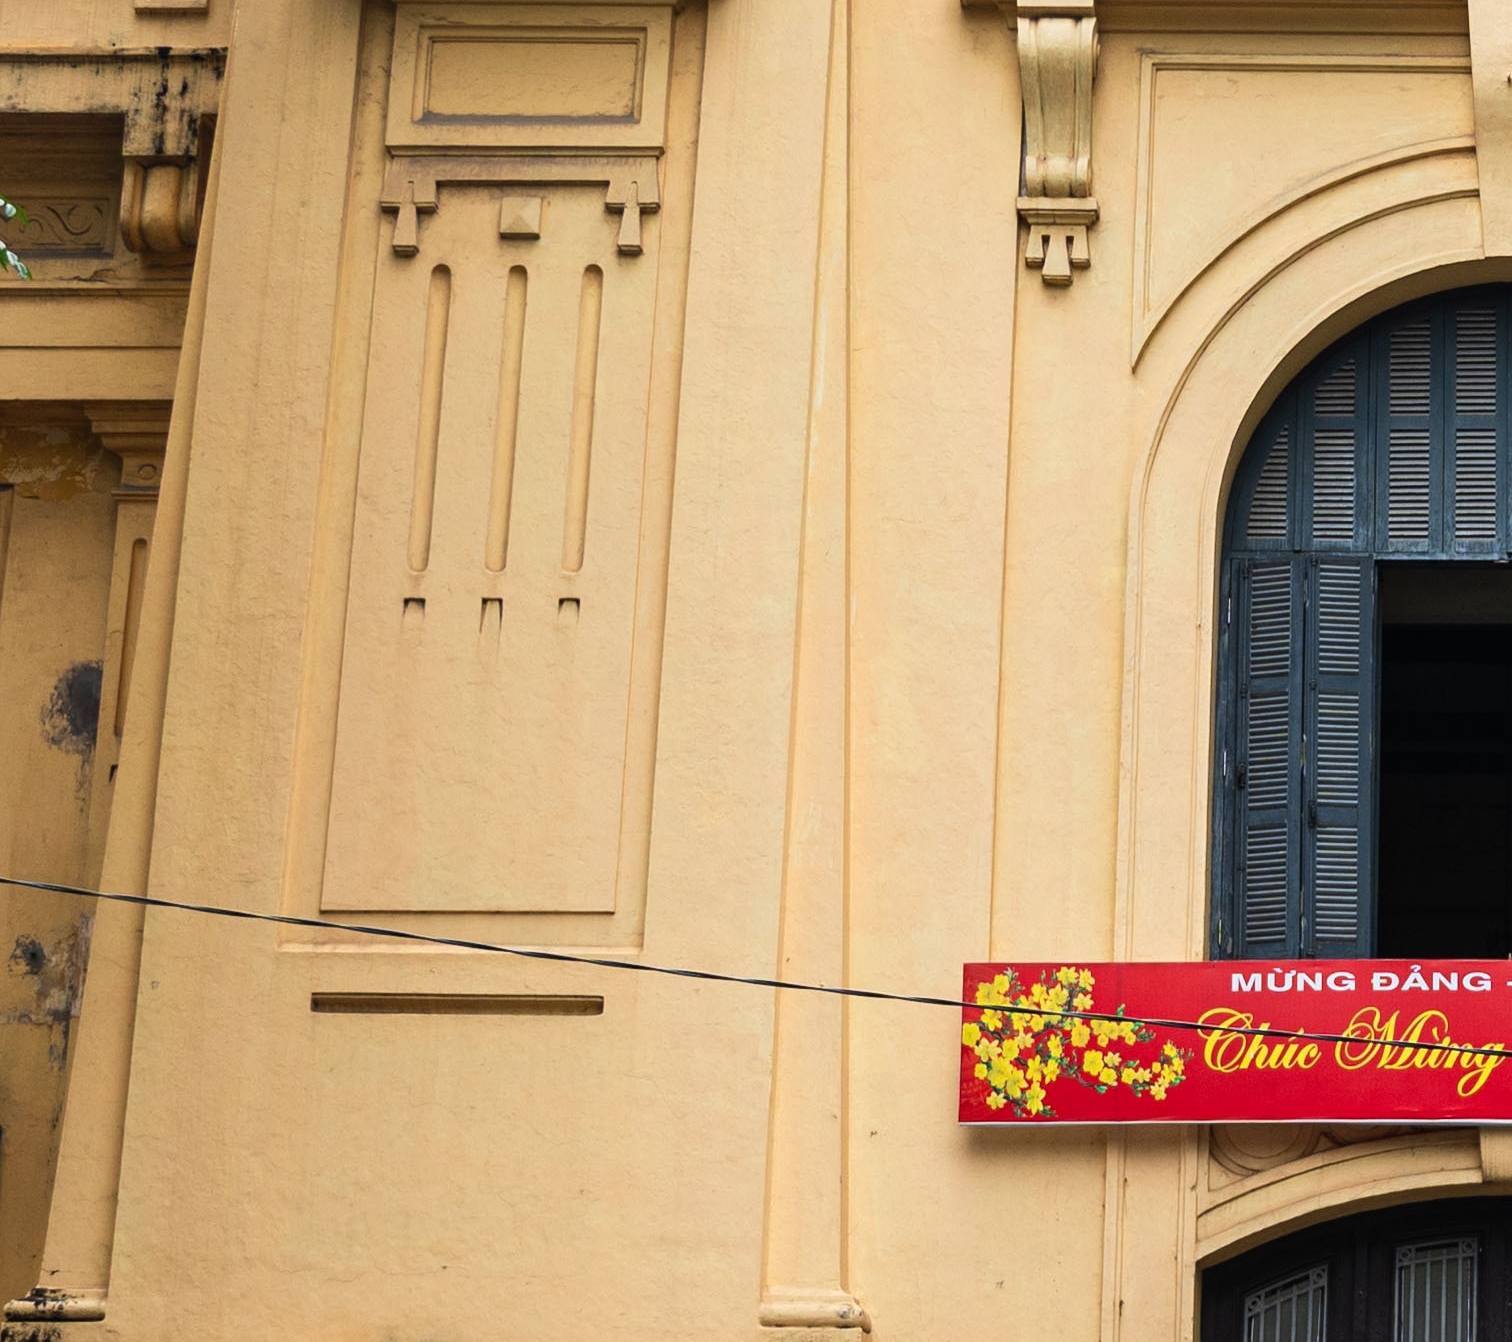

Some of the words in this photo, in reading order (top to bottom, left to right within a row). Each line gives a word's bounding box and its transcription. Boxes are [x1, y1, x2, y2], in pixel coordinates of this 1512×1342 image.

[1231, 967, 1356, 992] MỪNG
[1371, 964, 1492, 992] ĐẢNG
[1197, 1007, 1322, 1073] Chúc
[1335, 1006, 1507, 1097] Mừng
